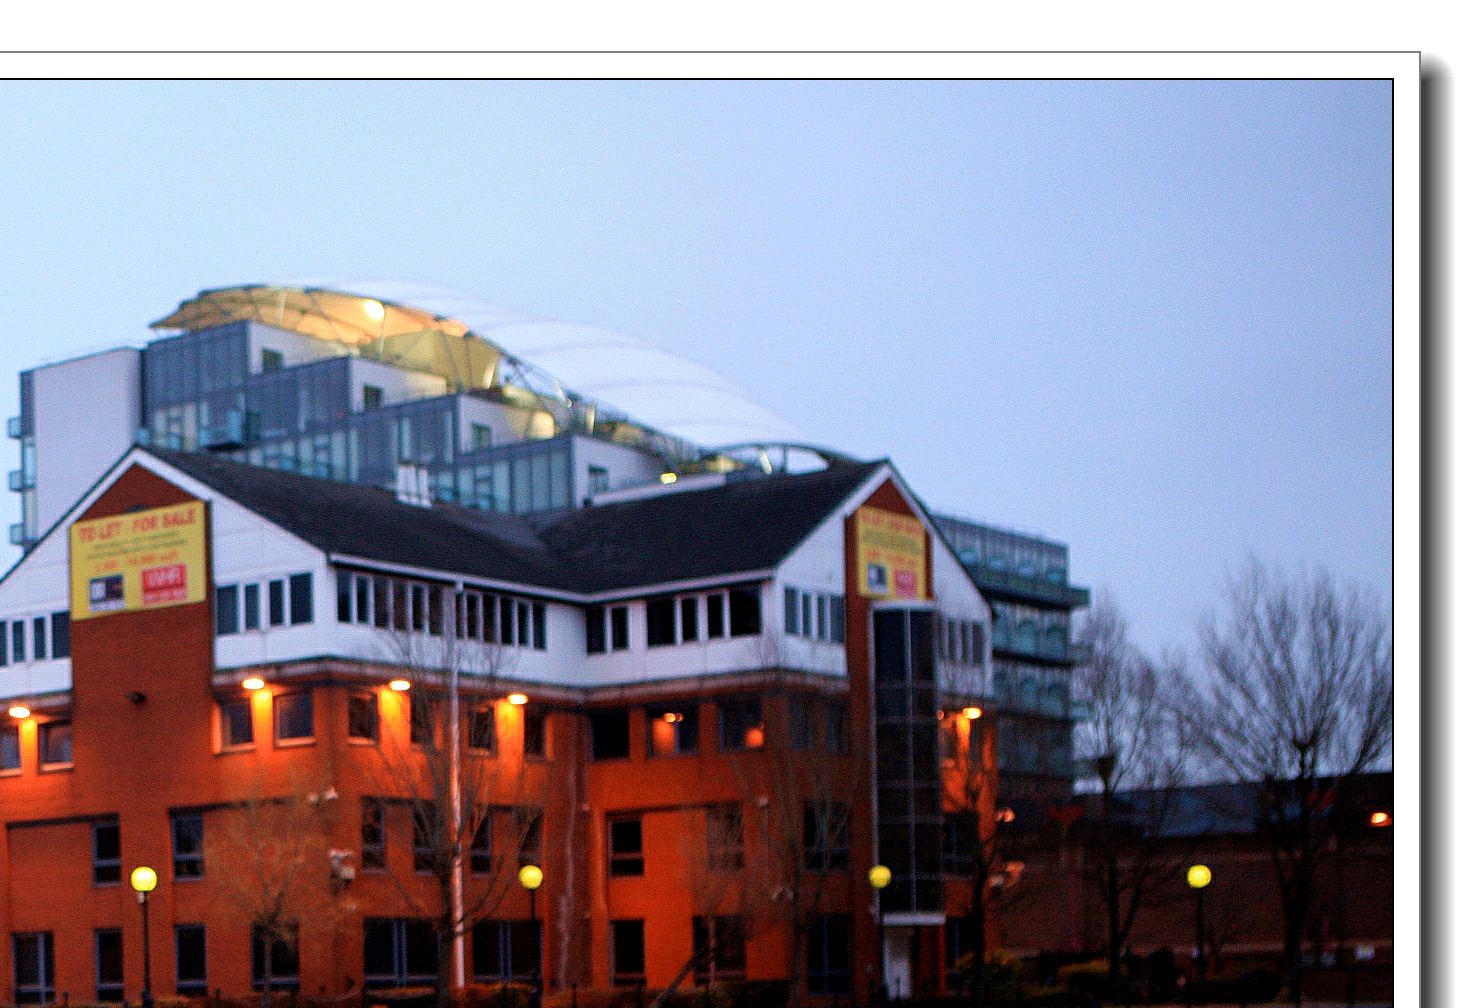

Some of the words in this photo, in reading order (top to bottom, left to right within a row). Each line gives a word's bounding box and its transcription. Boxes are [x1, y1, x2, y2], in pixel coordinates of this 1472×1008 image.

[79, 526, 96, 543] TO
[99, 520, 122, 540] LET
[133, 515, 158, 532] FOR
[162, 507, 197, 529] SALE
